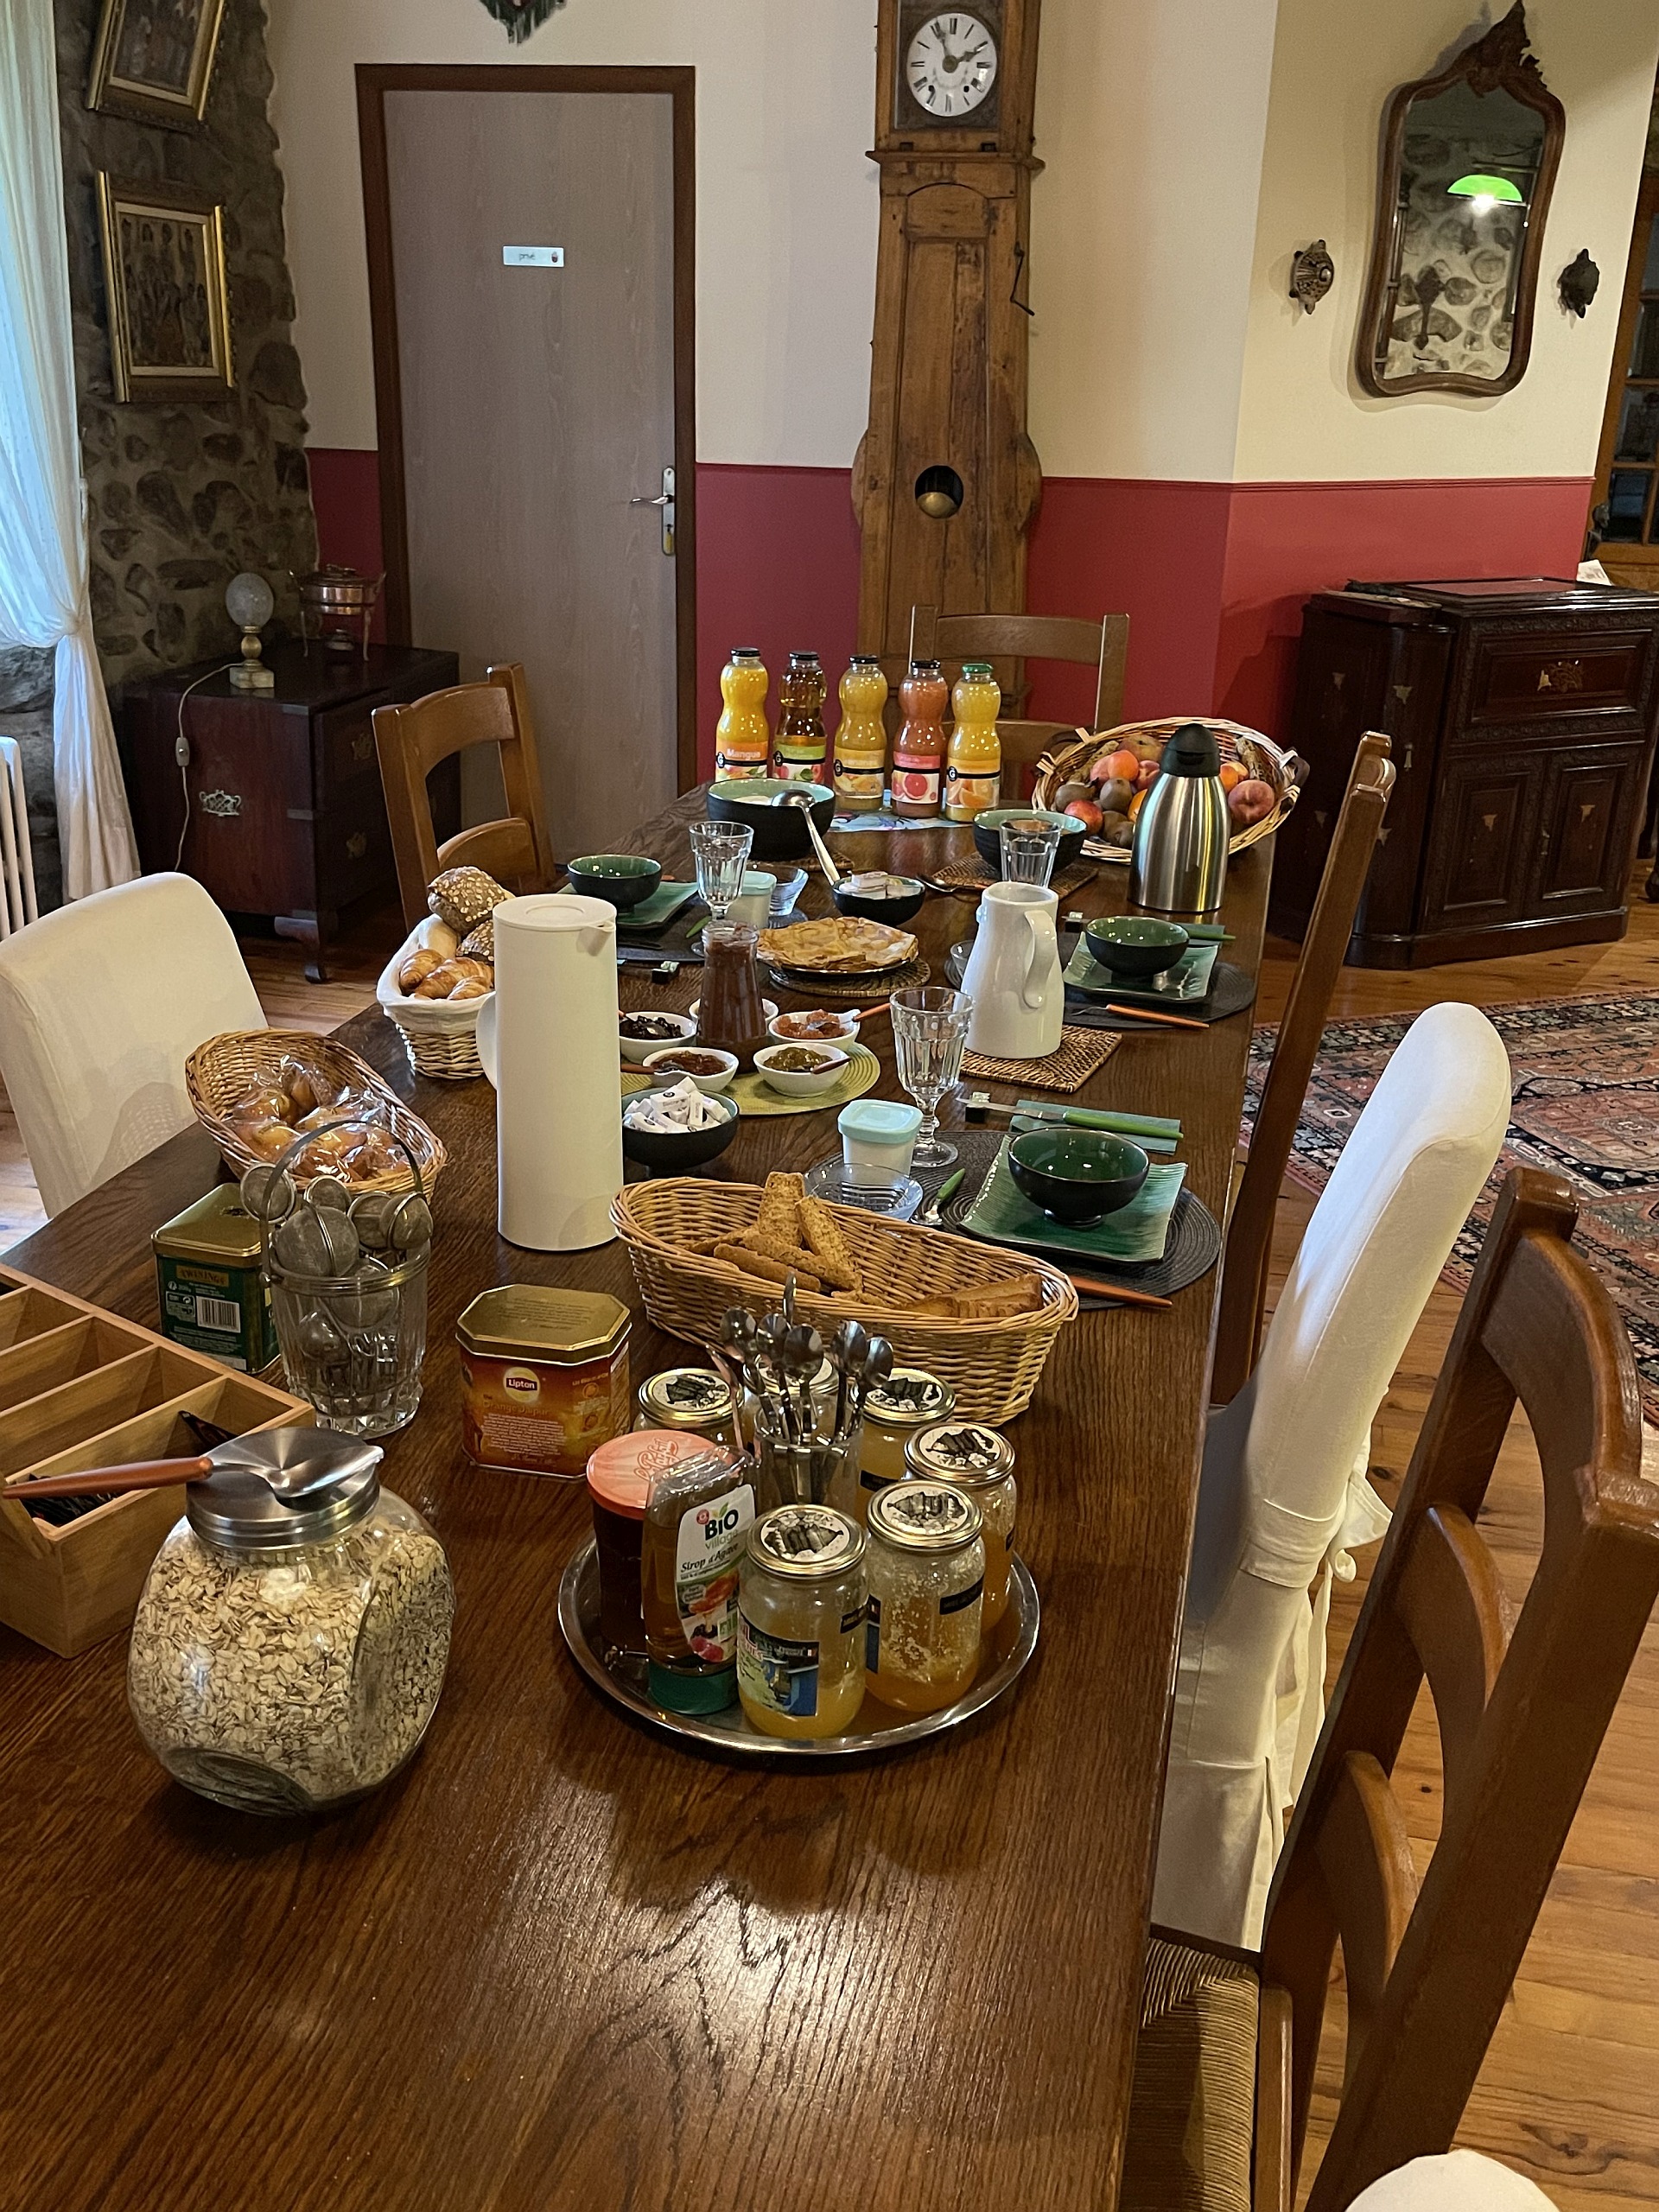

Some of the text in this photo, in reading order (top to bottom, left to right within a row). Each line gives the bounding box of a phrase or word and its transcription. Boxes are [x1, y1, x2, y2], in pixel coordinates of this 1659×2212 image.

[727, 747, 761, 761] Mangue
[508, 1378, 536, 1389] Lipton
[704, 1510, 740, 1541] BIO
[680, 1558, 706, 1573] Sirop
